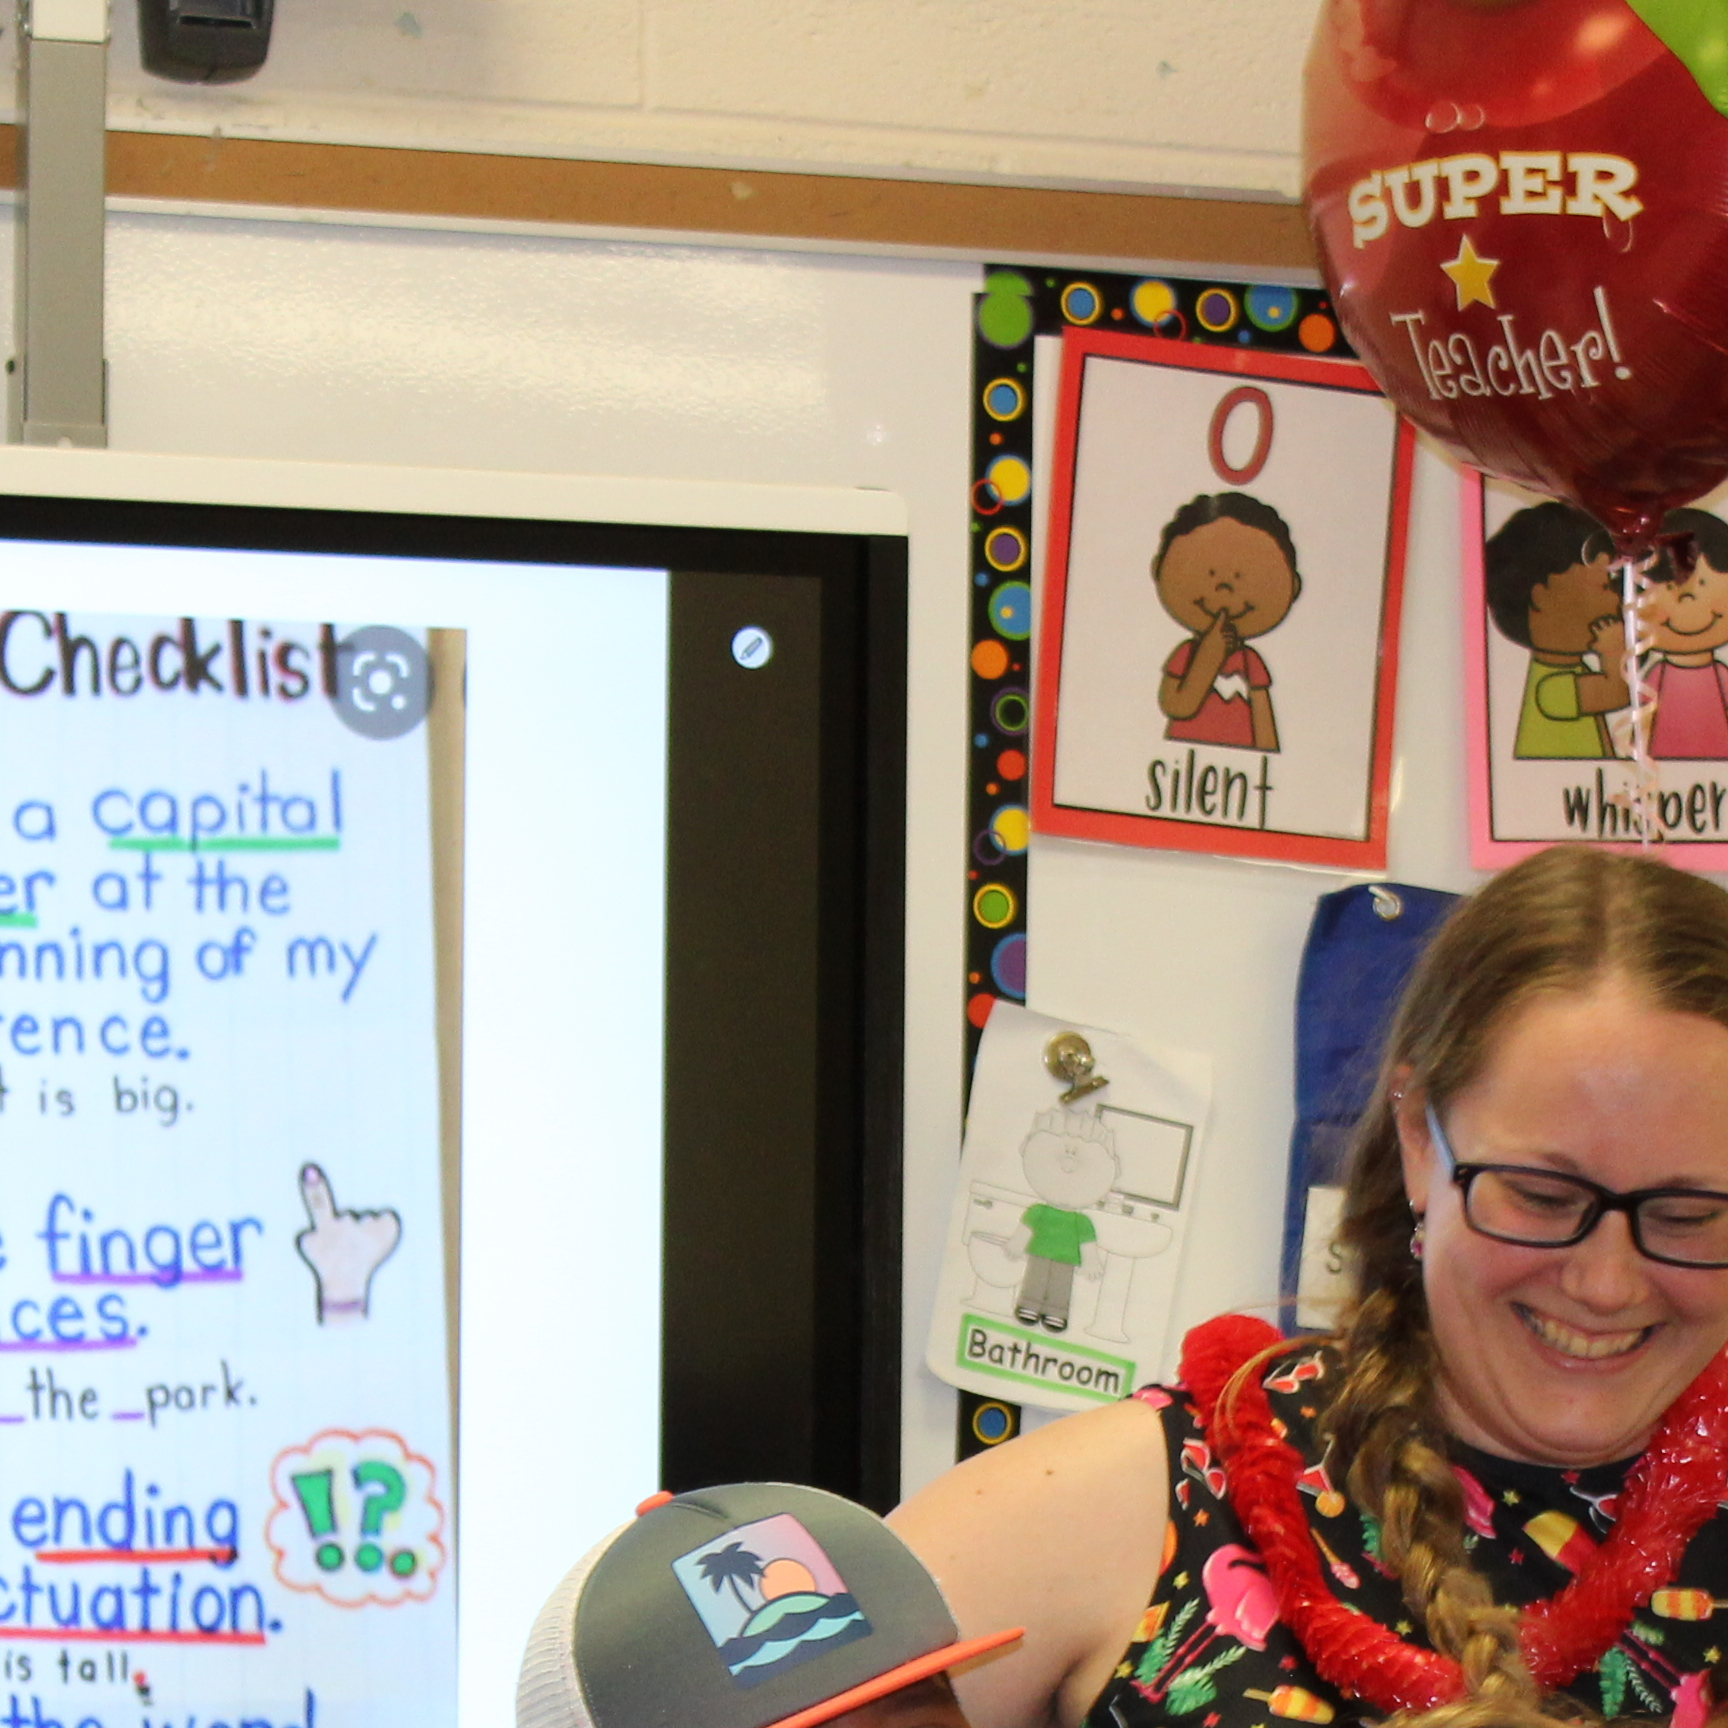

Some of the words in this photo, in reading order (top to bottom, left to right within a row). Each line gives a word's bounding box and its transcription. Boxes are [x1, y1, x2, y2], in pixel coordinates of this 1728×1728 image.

[1348, 151, 1642, 249] SUPER
[1390, 286, 1633, 402] Teacher!
[1209, 385, 1273, 485] 0
[14, 798, 57, 844] a
[92, 767, 343, 853] capital
[1145, 751, 1274, 833] silent
[1563, 776, 1727, 842] whisper
[92, 852, 162, 914] at
[186, 852, 292, 916] the
[195, 927, 259, 979] of
[287, 933, 379, 1003] my
[37, 1071, 74, 1117] is
[112, 1073, 195, 1127] big.
[43, 1193, 263, 1289] finger
[26, 1367, 99, 1420] the
[145, 1361, 258, 1428] park.
[966, 1329, 1122, 1395] Bathroom
[12, 1470, 238, 1563] ending
[3, 1650, 32, 1683] is
[59, 1650, 149, 1696] tall.
